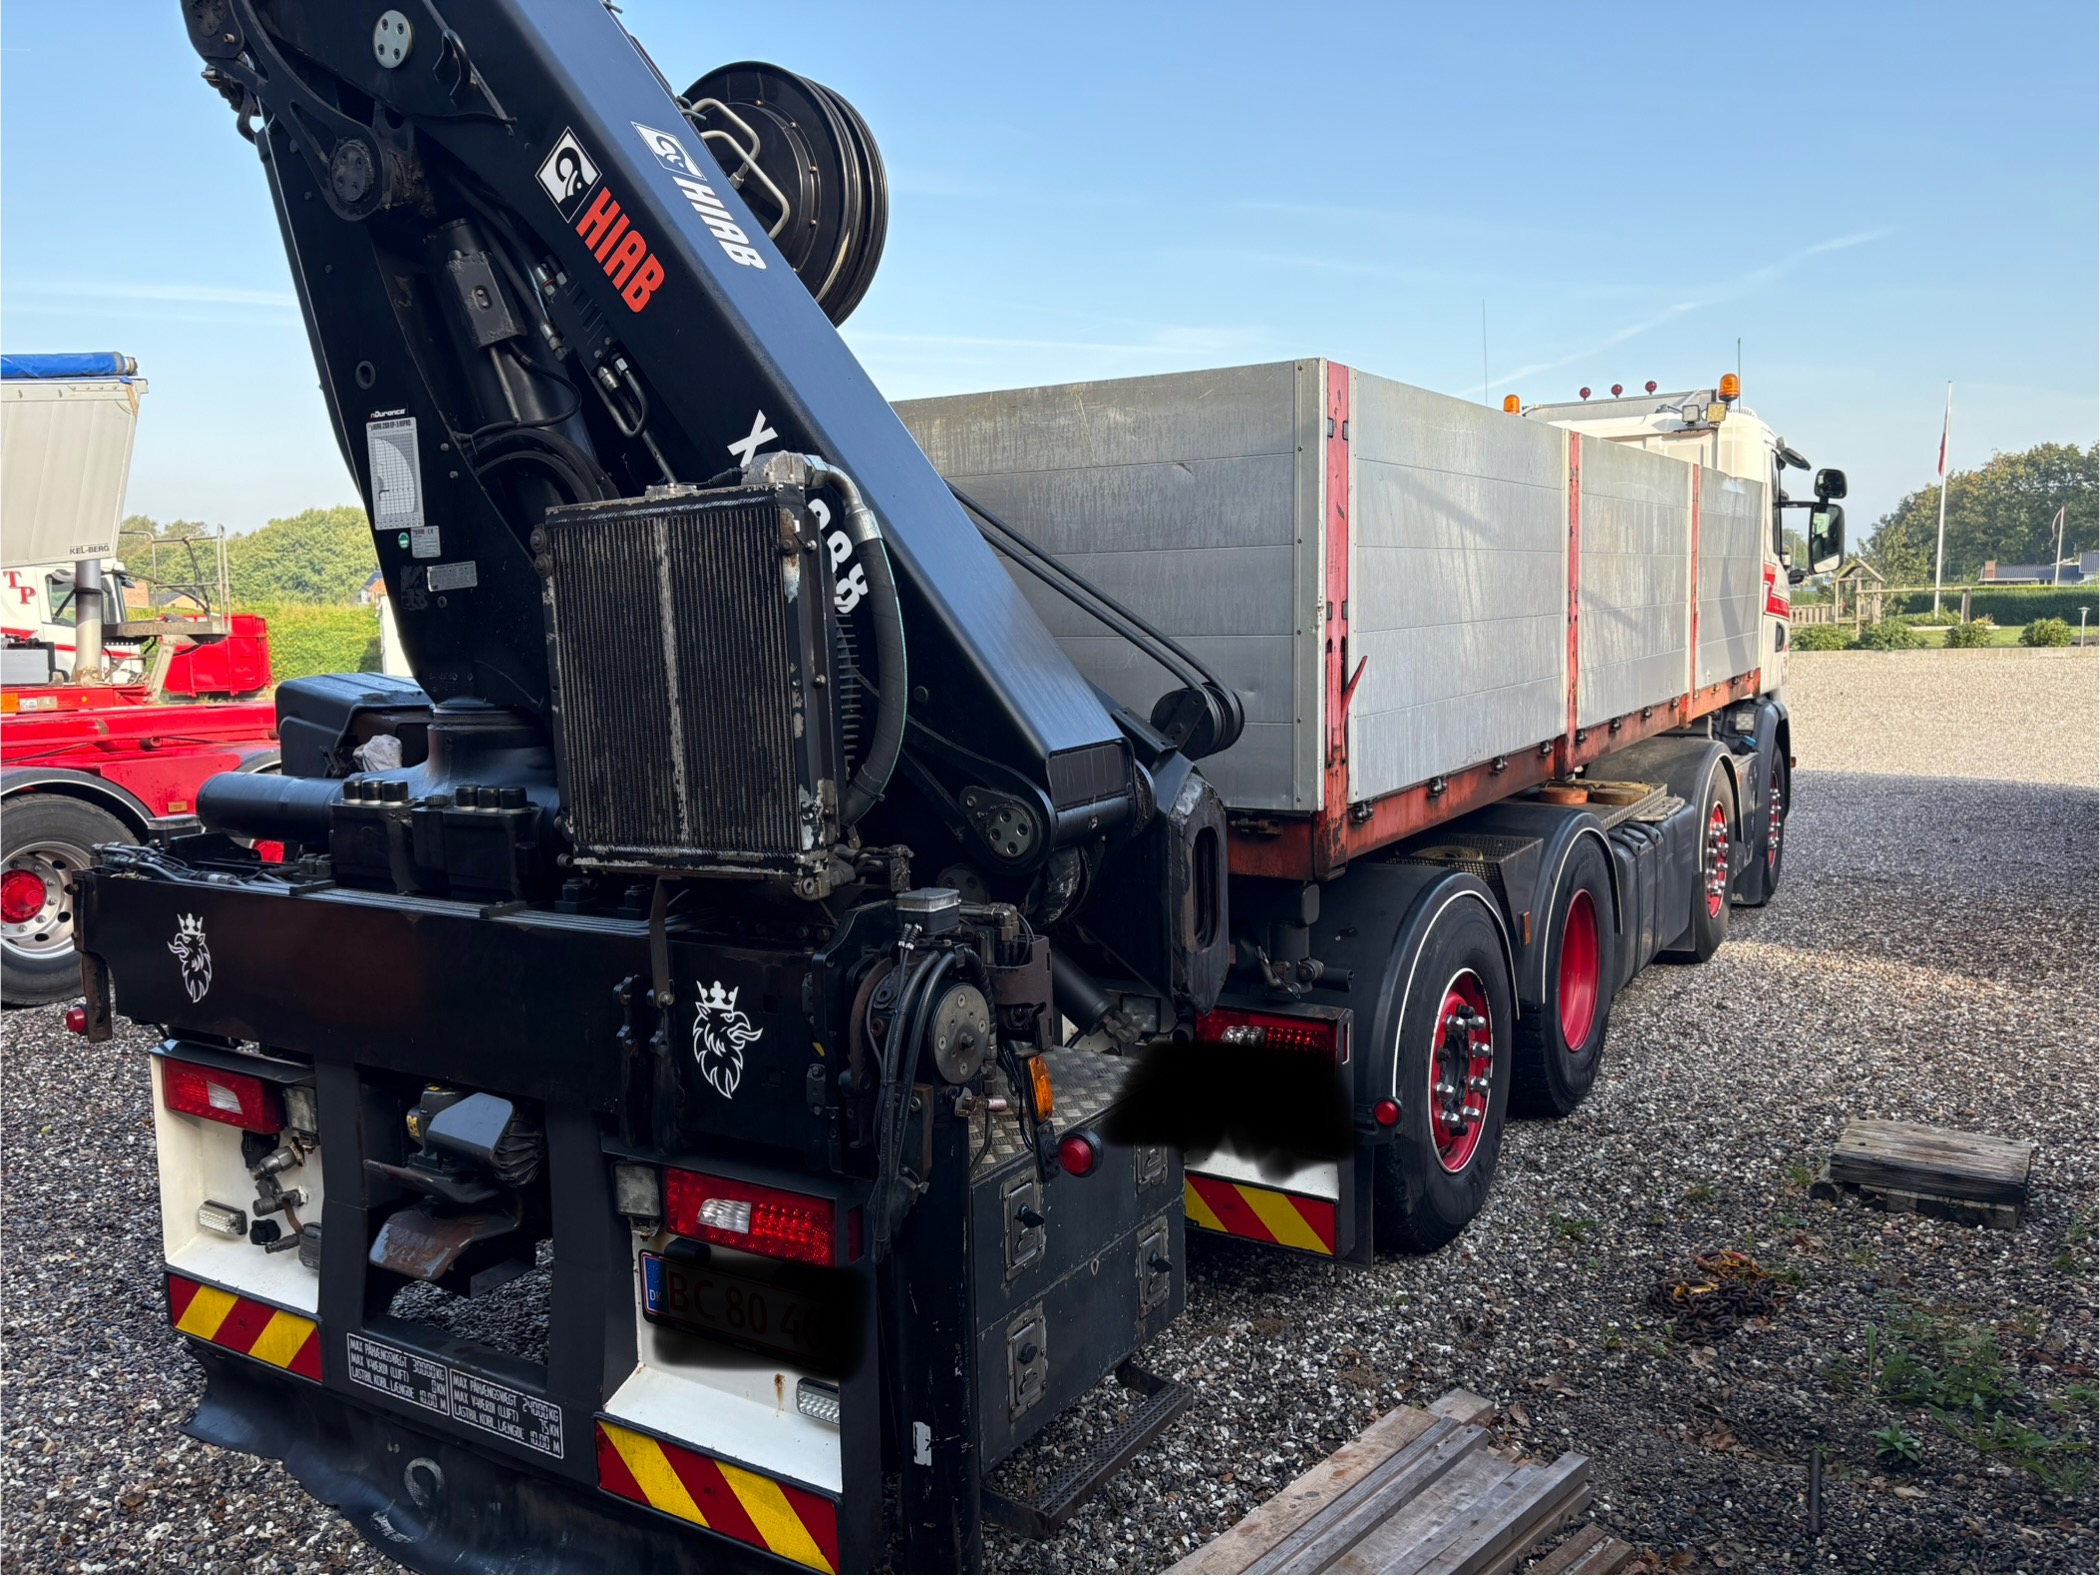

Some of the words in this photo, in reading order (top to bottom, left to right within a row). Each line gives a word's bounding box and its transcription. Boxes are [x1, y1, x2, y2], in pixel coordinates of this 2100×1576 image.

[673, 176, 767, 270] HIAB
[575, 186, 665, 313] HIAB
[69, 544, 110, 555] KEL-BERG
[350, 1338, 363, 1352] MAX
[350, 1352, 364, 1366] MAX
[390, 1366, 410, 1383] (LUFT)
[453, 1374, 468, 1390] MAX
[351, 1365, 374, 1384] LASTBIL
[440, 1398, 447, 1411] M
[454, 1389, 468, 1404] MAX
[498, 1404, 519, 1422] (LUFT)
[454, 1402, 478, 1422] LASTBIL
[552, 1440, 560, 1454] M
